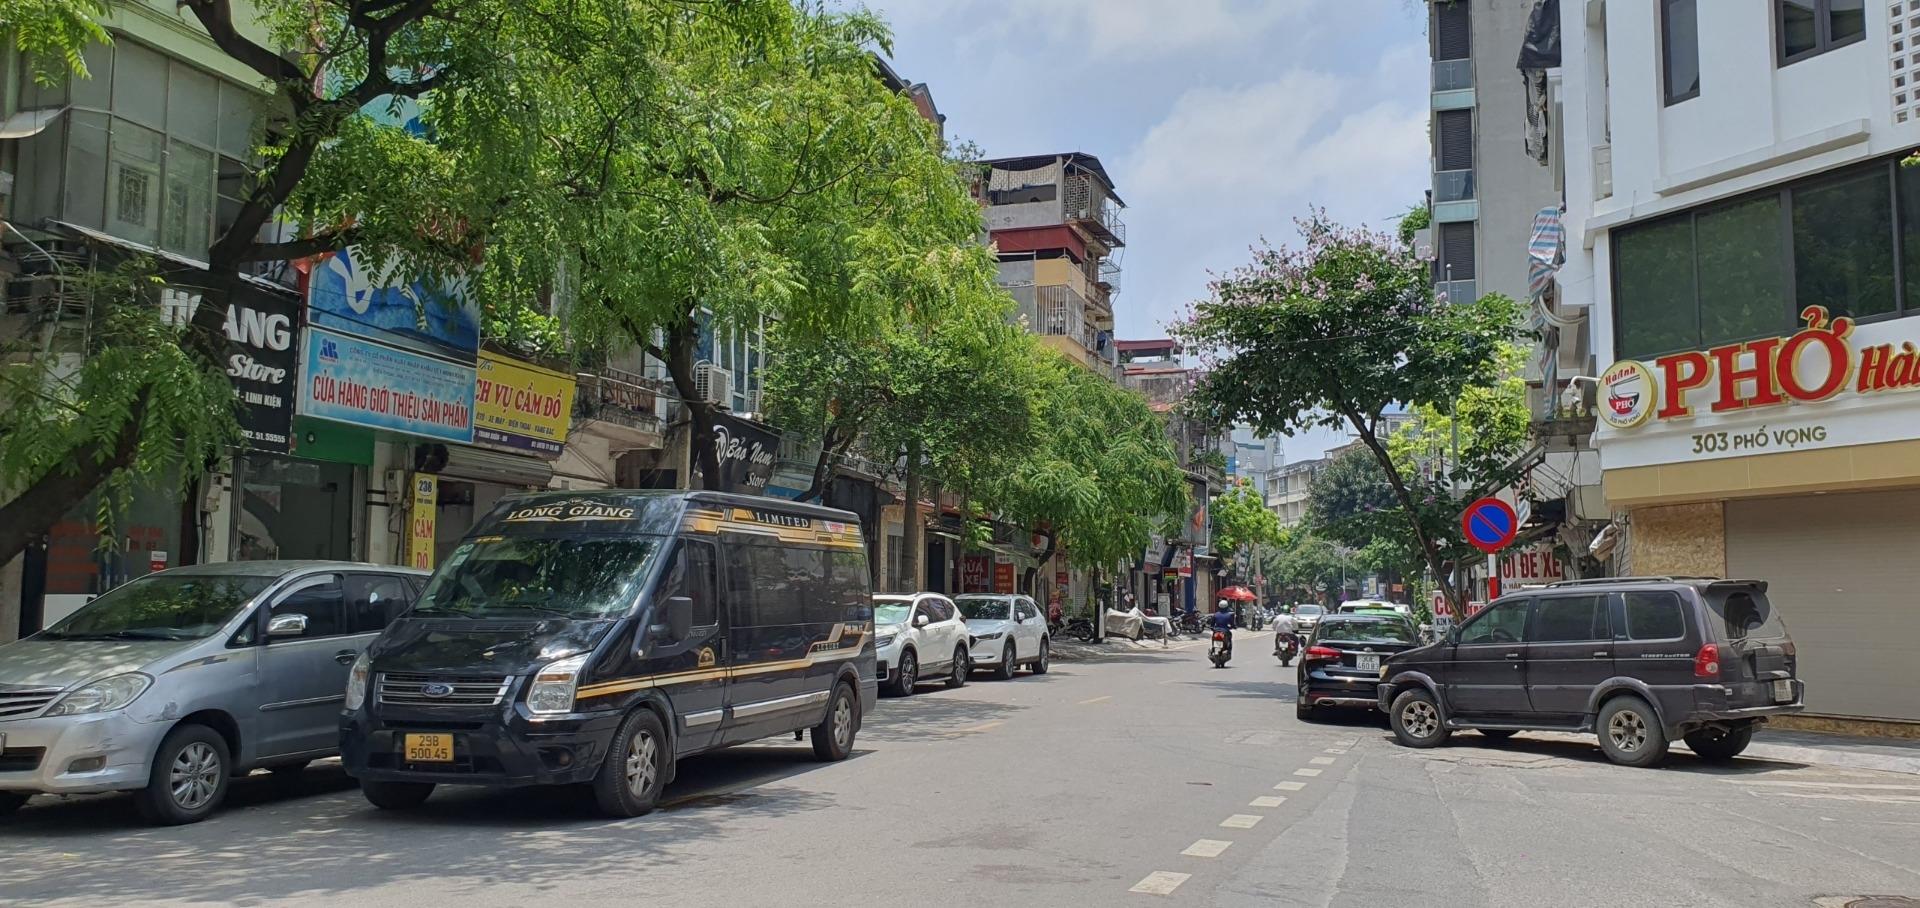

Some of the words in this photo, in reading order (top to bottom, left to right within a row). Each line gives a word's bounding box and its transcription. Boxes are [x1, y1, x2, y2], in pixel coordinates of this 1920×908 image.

[227, 353, 286, 384] Store
[1656, 305, 1854, 420] PHỞ
[313, 369, 336, 403] CỬA
[338, 377, 368, 410] HÀNG
[369, 384, 390, 416] GIỚI
[392, 390, 420, 423] THIỆU
[421, 392, 440, 424] SẢN
[442, 396, 468, 429] PHẨM
[495, 384, 514, 413] VỤ
[1692, 432, 1729, 454] 303
[1733, 425, 1769, 450] PHỐ
[1773, 426, 1827, 448] VỌNG
[727, 436, 748, 461] Bảo
[750, 441, 773, 466] Nam
[418, 480, 433, 493] 238
[746, 472, 767, 488] Store
[506, 506, 563, 520] LONG
[568, 505, 634, 518] GIANG
[756, 511, 809, 528] LIMITED
[1541, 551, 1561, 578] XE
[425, 684, 446, 694] Ford
[419, 735, 440, 747] 29B
[410, 747, 448, 759] 500.45
